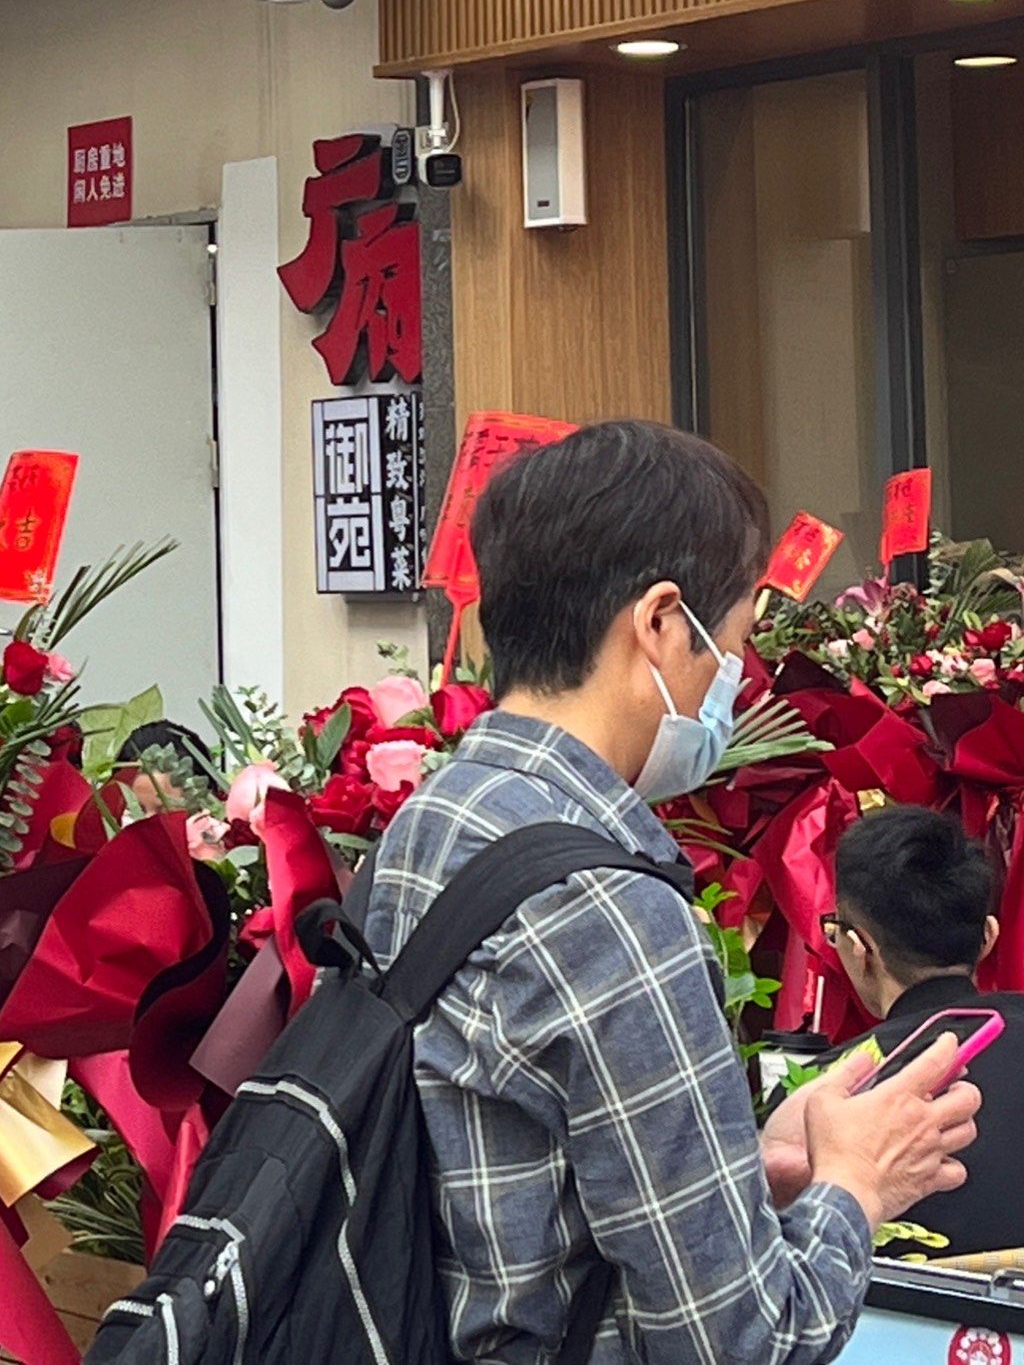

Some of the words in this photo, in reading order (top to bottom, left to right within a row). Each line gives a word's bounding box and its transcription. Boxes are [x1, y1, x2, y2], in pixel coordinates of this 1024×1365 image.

[326, 422, 373, 568] 御苑
[385, 395, 412, 591] 精致粤菜
